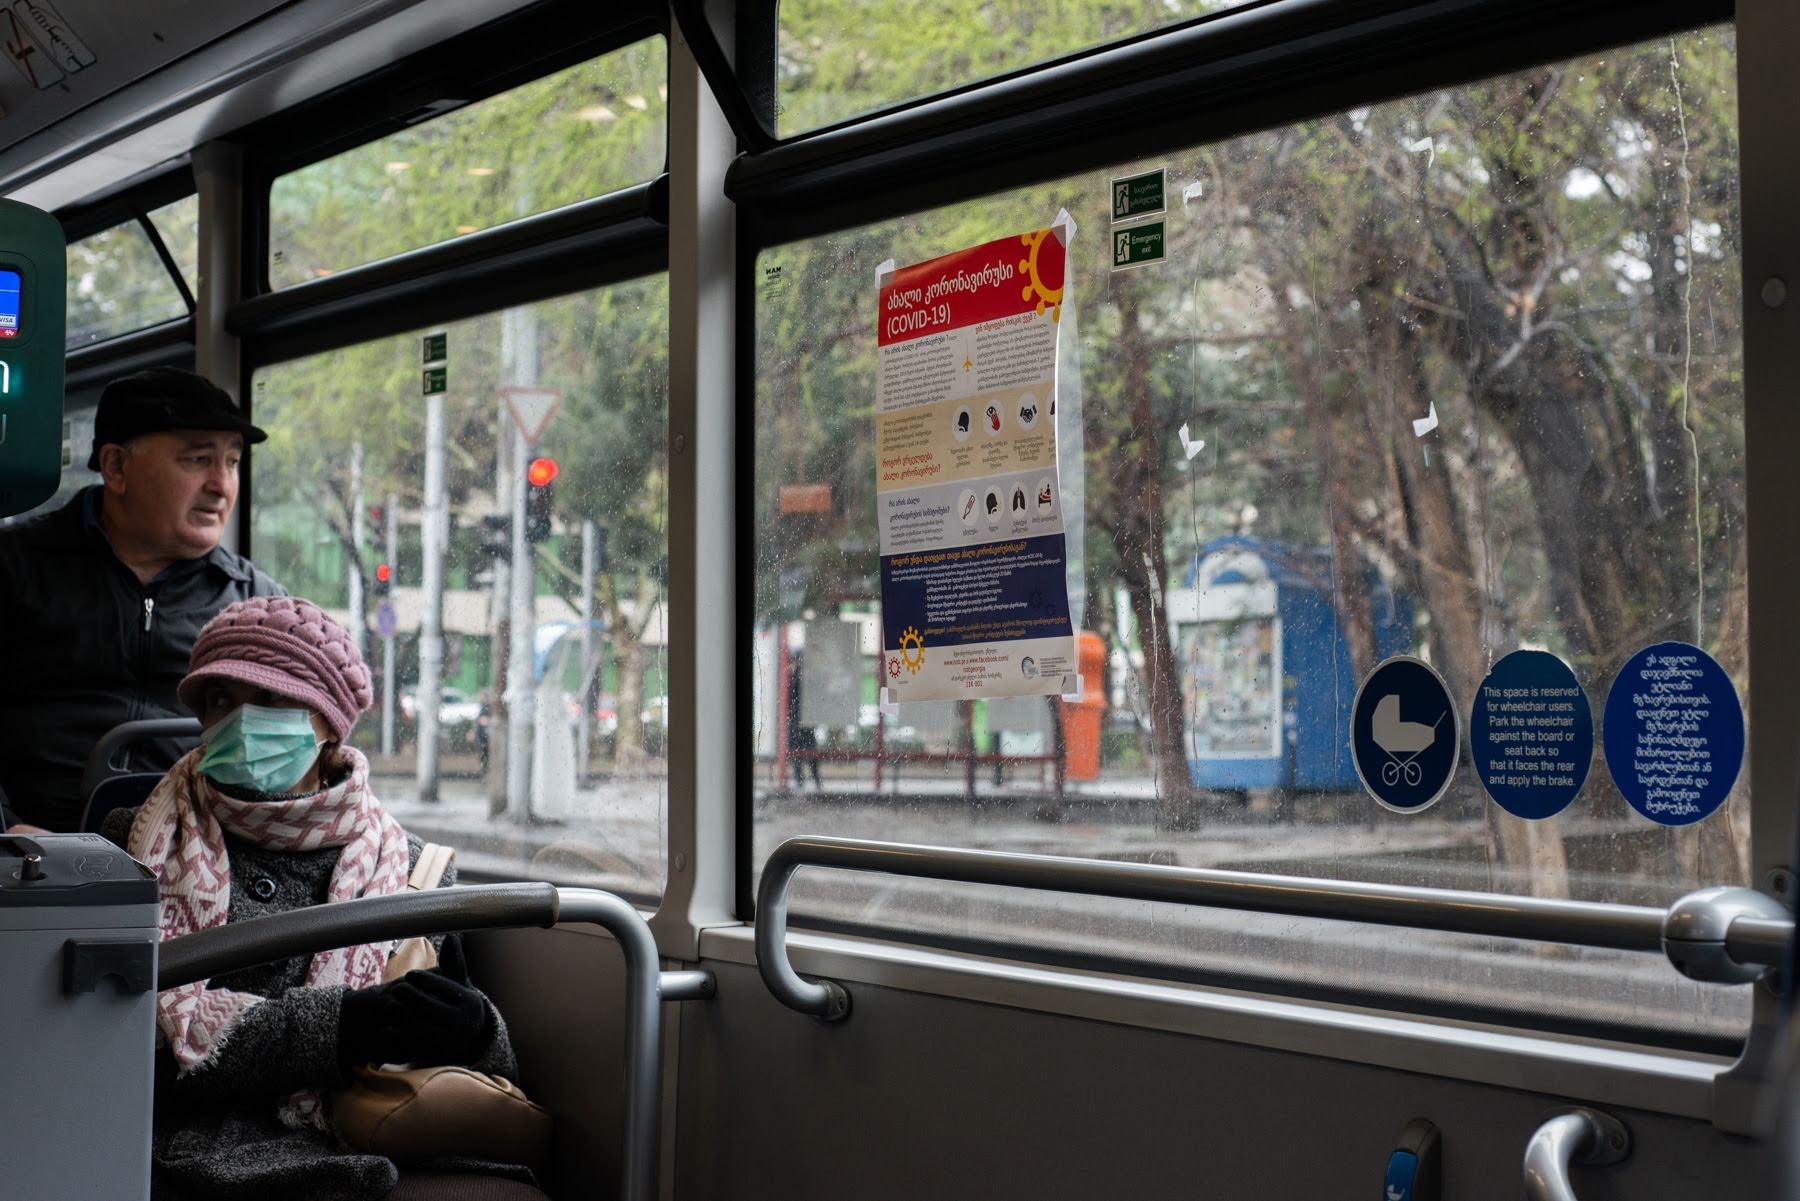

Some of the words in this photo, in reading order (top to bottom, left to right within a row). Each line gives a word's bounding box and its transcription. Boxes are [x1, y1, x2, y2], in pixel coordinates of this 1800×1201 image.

[1132, 232, 1162, 244] Emergency
[1142, 246, 1152, 254] exit
[888, 288, 922, 310] ახალი
[925, 259, 1013, 304] კორონავირუსი
[887, 302, 950, 338] (COVID-19)
[1646, 654, 1656, 667] ეს
[1659, 656, 1697, 667] ადგილი
[1483, 687, 1501, 697] This
[1504, 688, 1529, 699] space
[1531, 687, 1538, 696] is
[1540, 687, 1579, 696] reserved
[1651, 681, 1693, 693] ეტლიანი
[1487, 702, 1498, 711] for
[1501, 702, 1546, 711] wheelchair
[1549, 703, 1575, 711] users.
[1633, 694, 1711, 707] მგზავრებისთვის.
[1681, 708, 1709, 720] ეტლი
[1489, 716, 1509, 726] Park
[1511, 716, 1524, 726] the
[1527, 716, 1574, 726] wheelchair
[1646, 720, 1699, 734] მგზავრების
[1489, 732, 1520, 743] against
[1522, 731, 1535, 741] the
[1538, 731, 1563, 741] board
[1565, 733, 1575, 741] or
[1638, 734, 1707, 748] საწინააღმდეგო
[1505, 746, 1523, 756] seat
[1525, 746, 1545, 756] back
[1548, 748, 1559, 756] so
[1636, 747, 1710, 761] მიმართულებით
[1490, 760, 1506, 770] that
[1508, 760, 1513, 770] it
[1515, 760, 1538, 770] faces
[1541, 761, 1554, 771] the
[1557, 763, 1575, 771] rear
[1702, 762, 1712, 772] ან
[1489, 775, 1505, 784] and
[1507, 775, 1530, 787] apply
[1532, 775, 1546, 785] the
[1548, 775, 1576, 786] brake.
[1695, 778, 1708, 788] და
[1647, 788, 1700, 801] გამოიყენეთ
